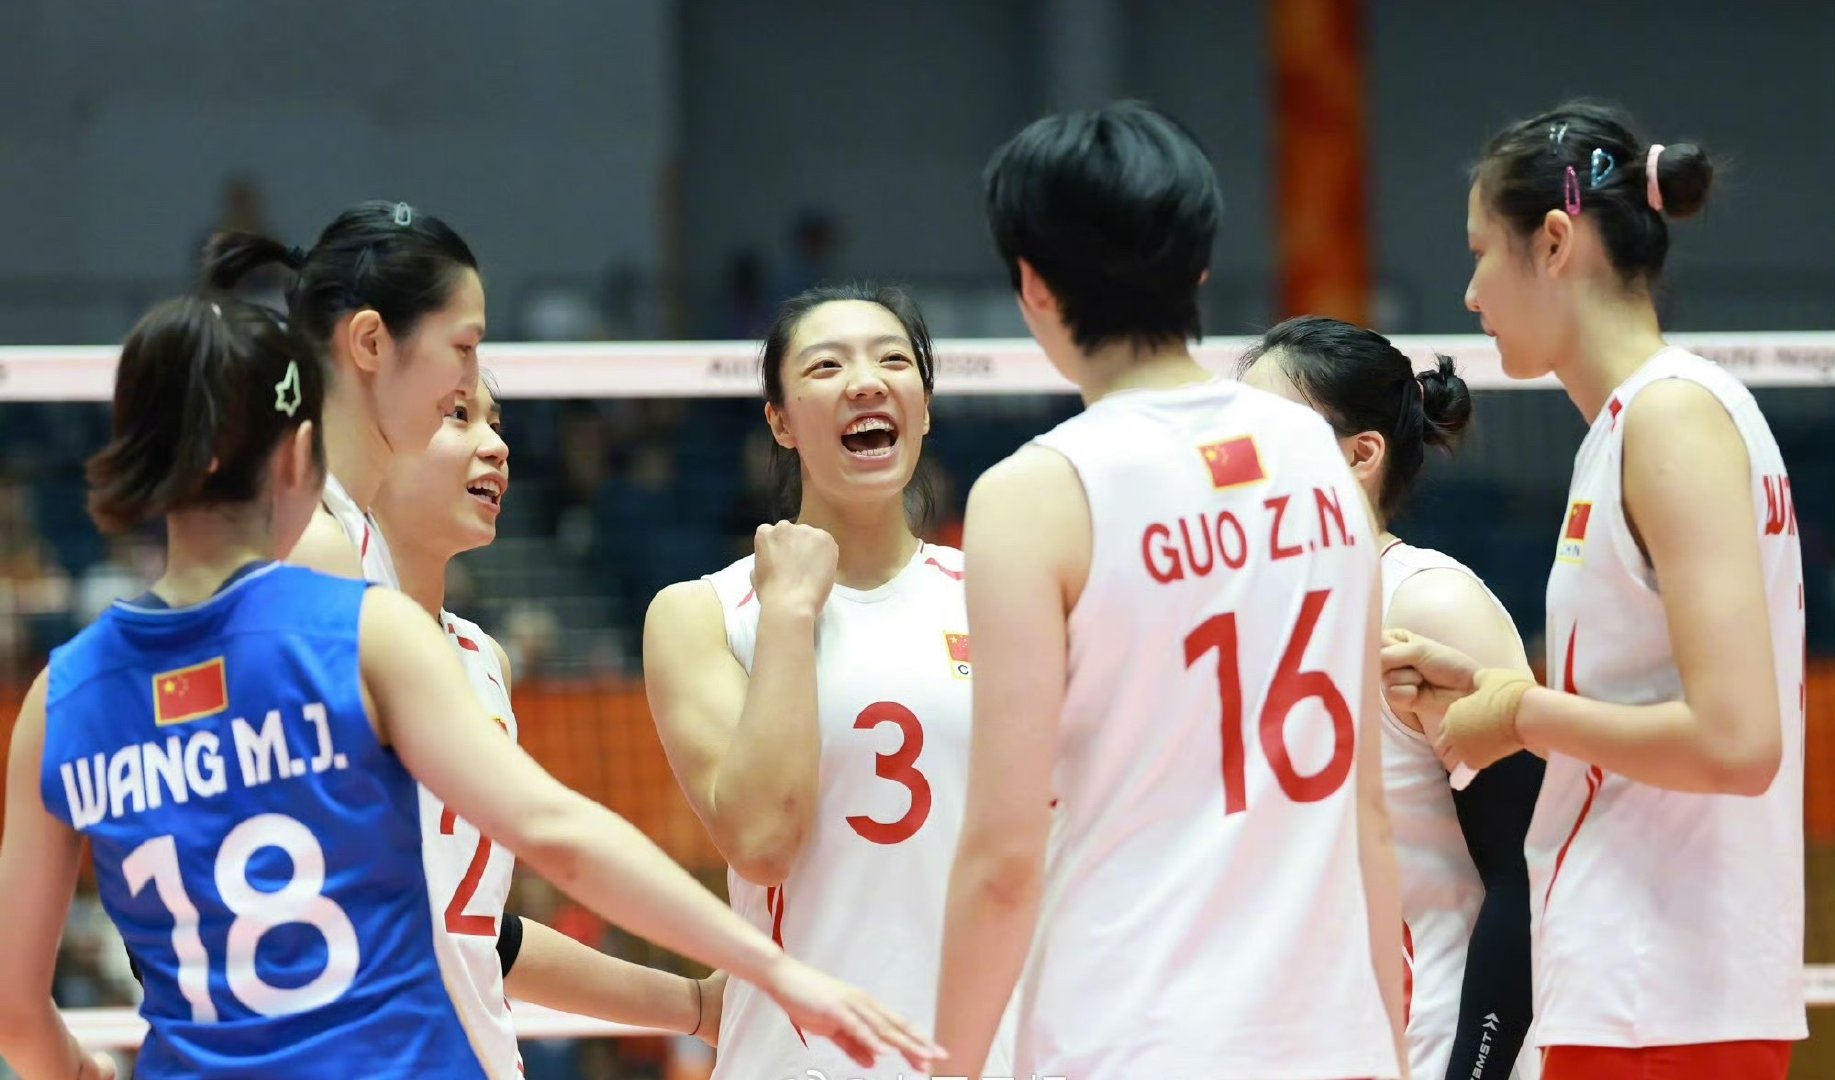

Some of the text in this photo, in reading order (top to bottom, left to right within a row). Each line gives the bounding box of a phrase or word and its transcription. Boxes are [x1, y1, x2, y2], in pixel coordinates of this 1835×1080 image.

[1142, 486, 1356, 583] GUO Z.N.
[60, 702, 349, 830] WANG M.J.
[1184, 588, 1355, 816] 16
[845, 701, 932, 844] 3
[121, 812, 361, 1024] 18
[1470, 1031, 1493, 1080] AMST
